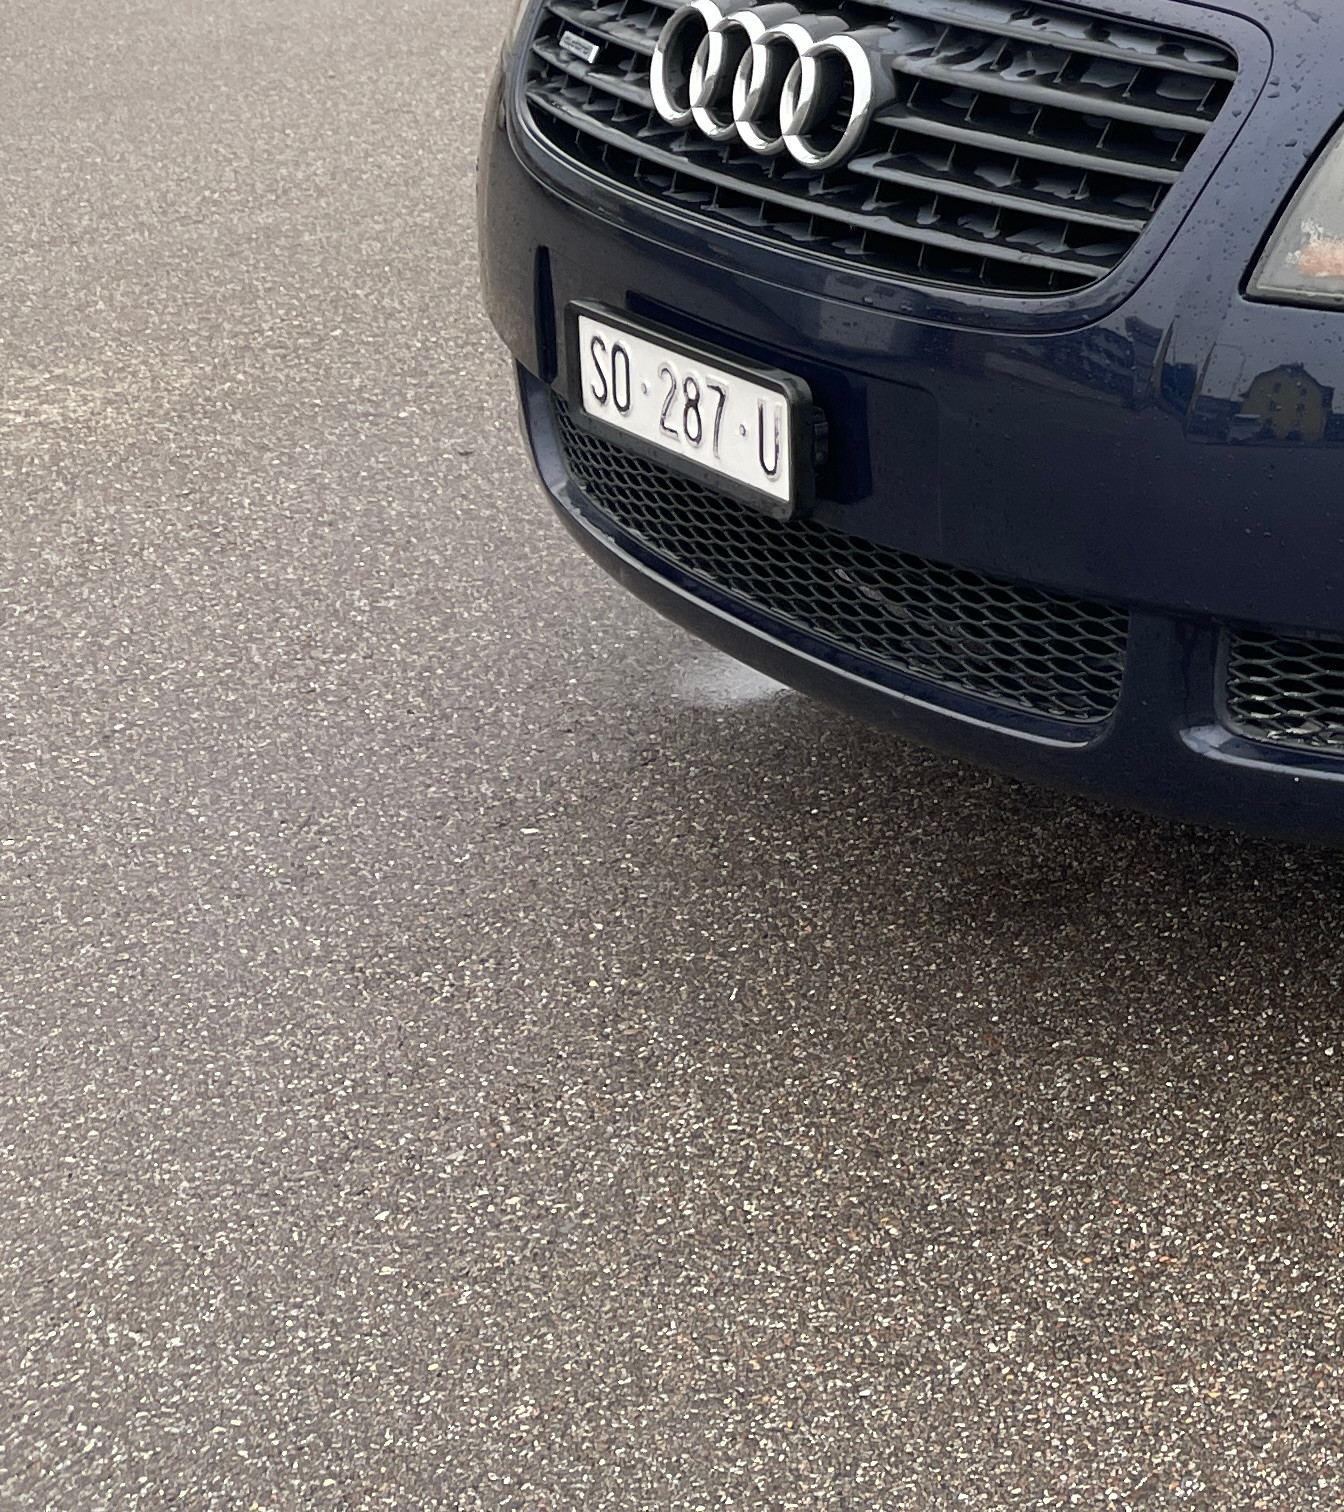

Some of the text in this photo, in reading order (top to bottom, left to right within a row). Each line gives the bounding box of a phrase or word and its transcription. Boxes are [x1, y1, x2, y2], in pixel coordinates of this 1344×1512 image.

[591, 335, 783, 481] SO 287 U
